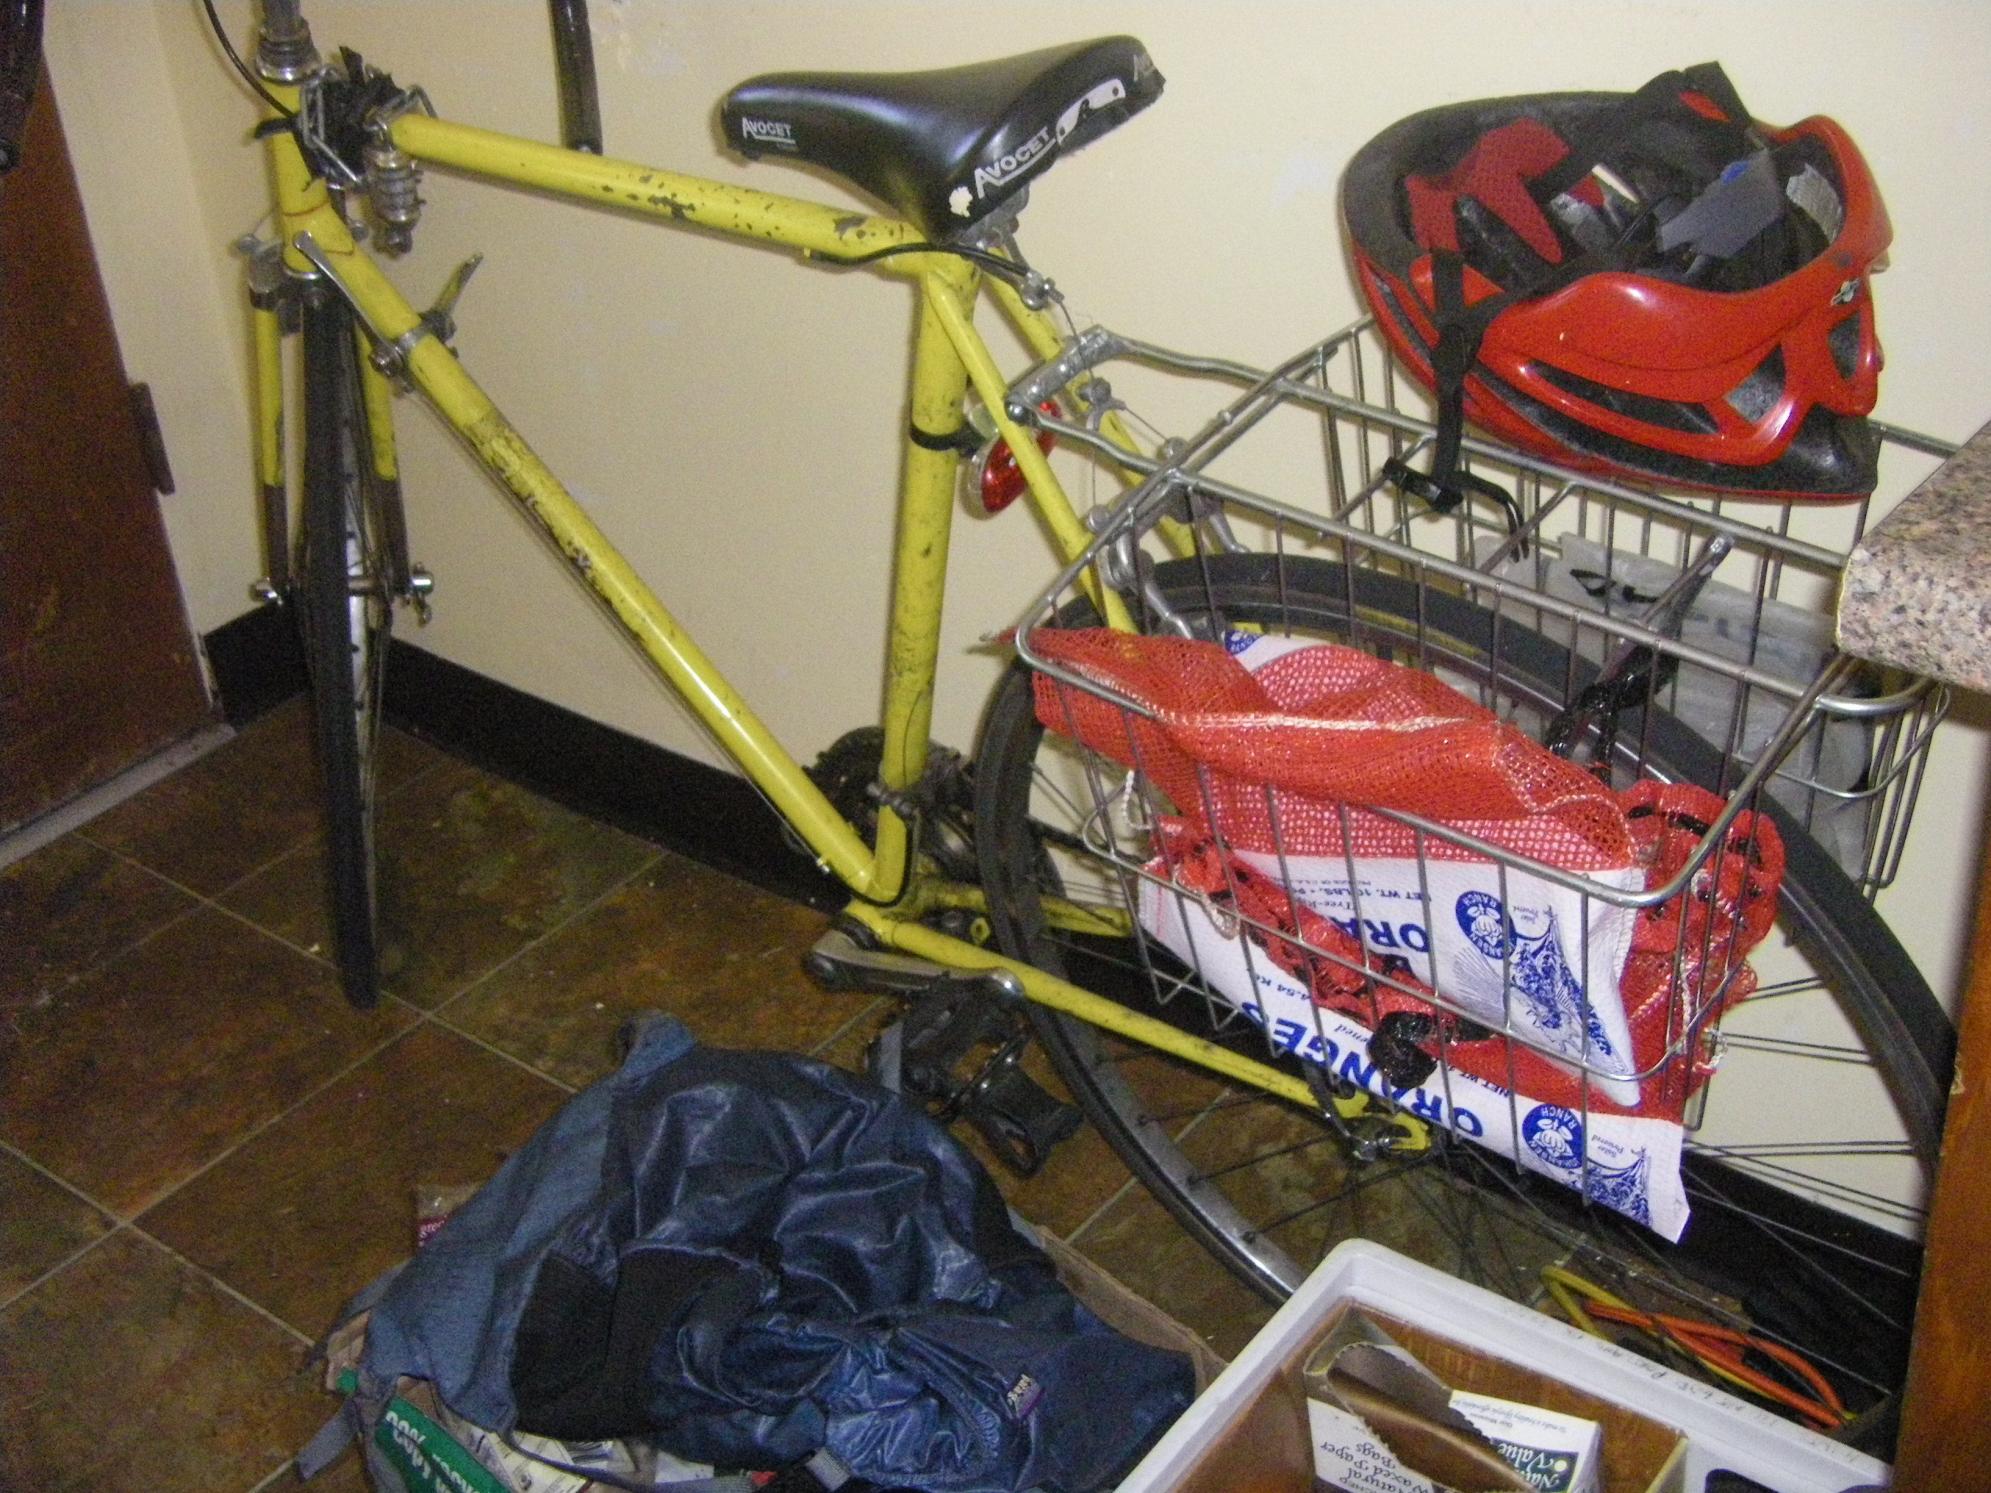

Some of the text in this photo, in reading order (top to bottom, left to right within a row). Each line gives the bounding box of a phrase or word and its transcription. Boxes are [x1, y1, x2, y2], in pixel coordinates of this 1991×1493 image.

[742, 117, 793, 140] AVOCET
[974, 126, 1054, 199] AVOCET
[1462, 894, 1498, 909] RANCH
[1482, 1081, 1511, 1098] NET
[1540, 1105, 1578, 1130] RANCH
[1320, 1440, 1429, 1493] Waxed Paper
[1355, 1441, 1396, 1470] Bags
[1499, 1441, 1556, 1470] Value
